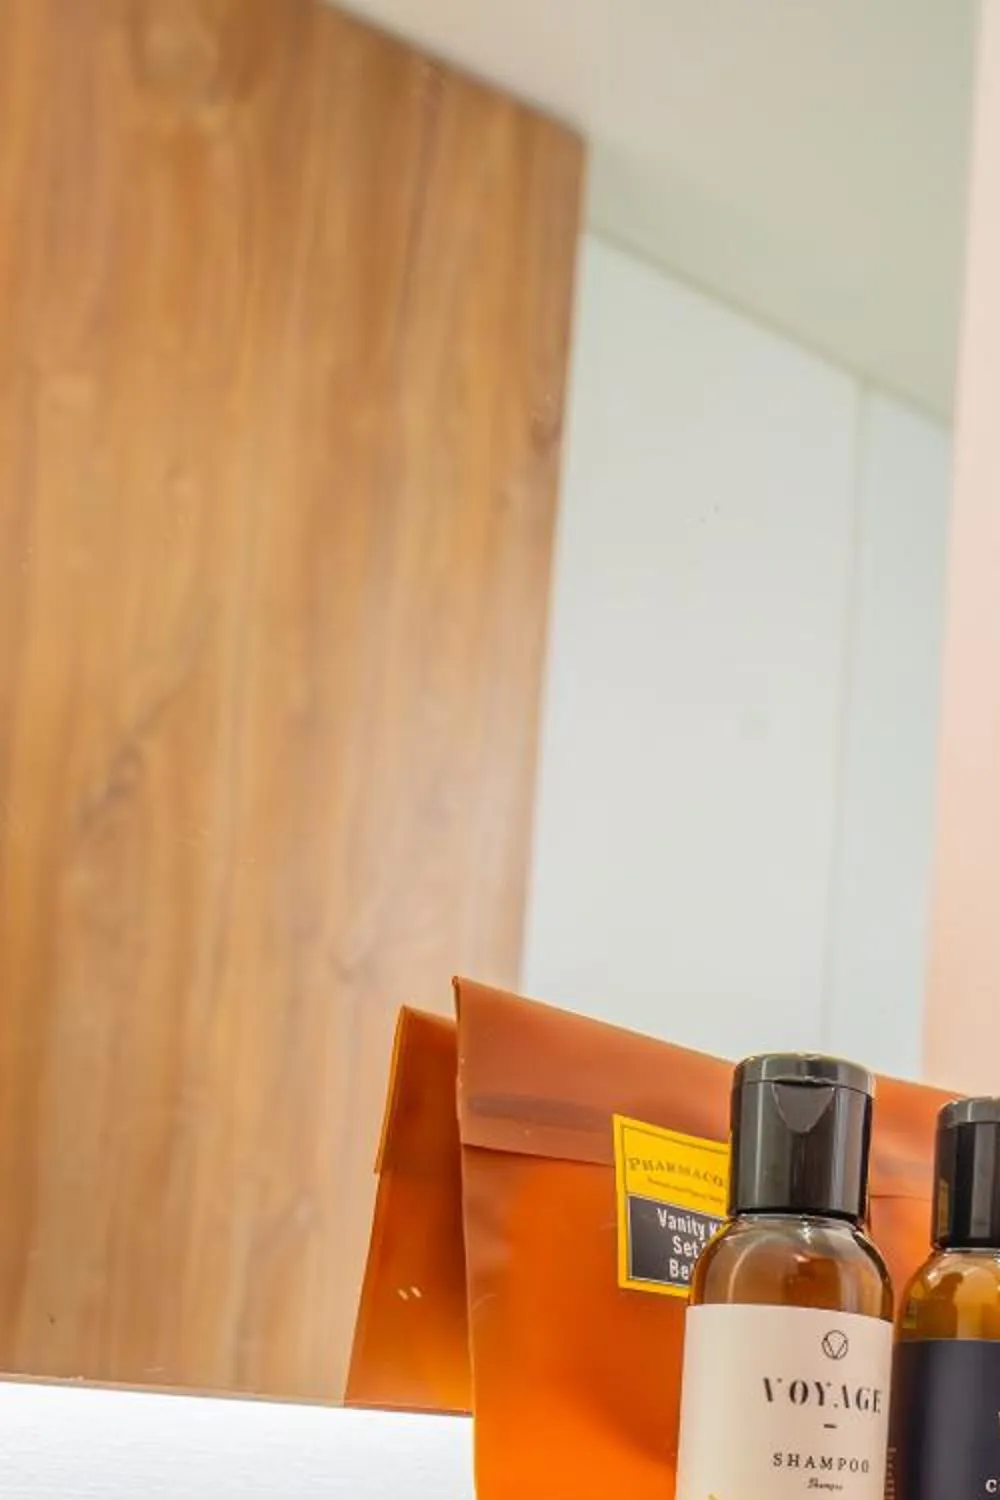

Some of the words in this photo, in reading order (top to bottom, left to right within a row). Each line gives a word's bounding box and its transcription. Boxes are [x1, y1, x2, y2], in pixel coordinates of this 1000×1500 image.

[628, 1157, 725, 1187] PHARMACO
[657, 1207, 705, 1240] Vanity
[672, 1235, 699, 1258] Set
[762, 1376, 884, 1413] VOYAGE
[773, 1452, 870, 1474] SHAMPOO
